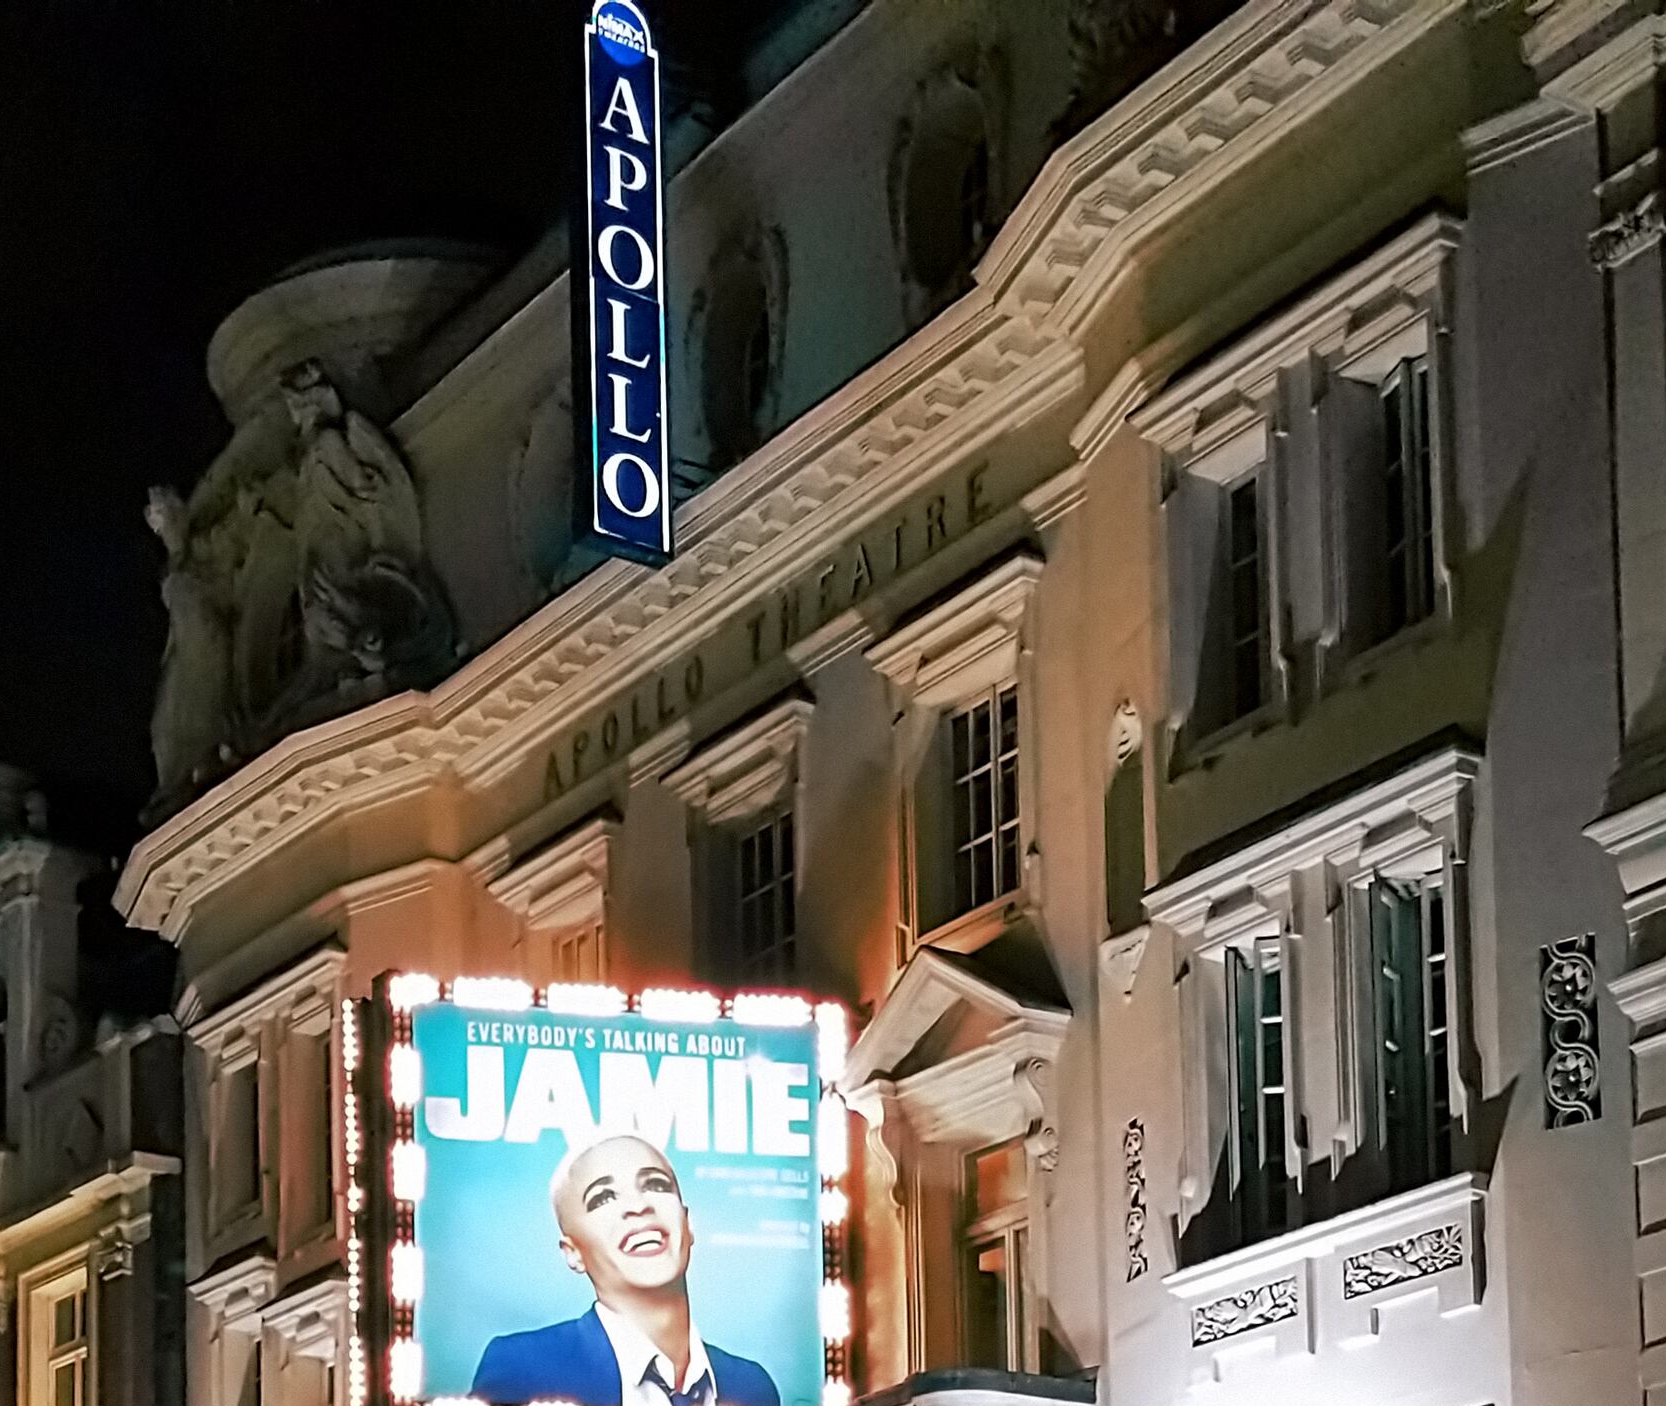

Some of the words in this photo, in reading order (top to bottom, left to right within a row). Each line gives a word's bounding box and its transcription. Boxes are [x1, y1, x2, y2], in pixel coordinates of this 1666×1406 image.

[598, 76, 661, 518] APOLLO
[543, 655, 704, 801] APOLLO
[424, 1044, 811, 1157] JAMIE
[466, 1021, 596, 1049] EVERYBODY'S
[602, 1027, 680, 1055] TALKING
[685, 1034, 746, 1058] ABOUT
